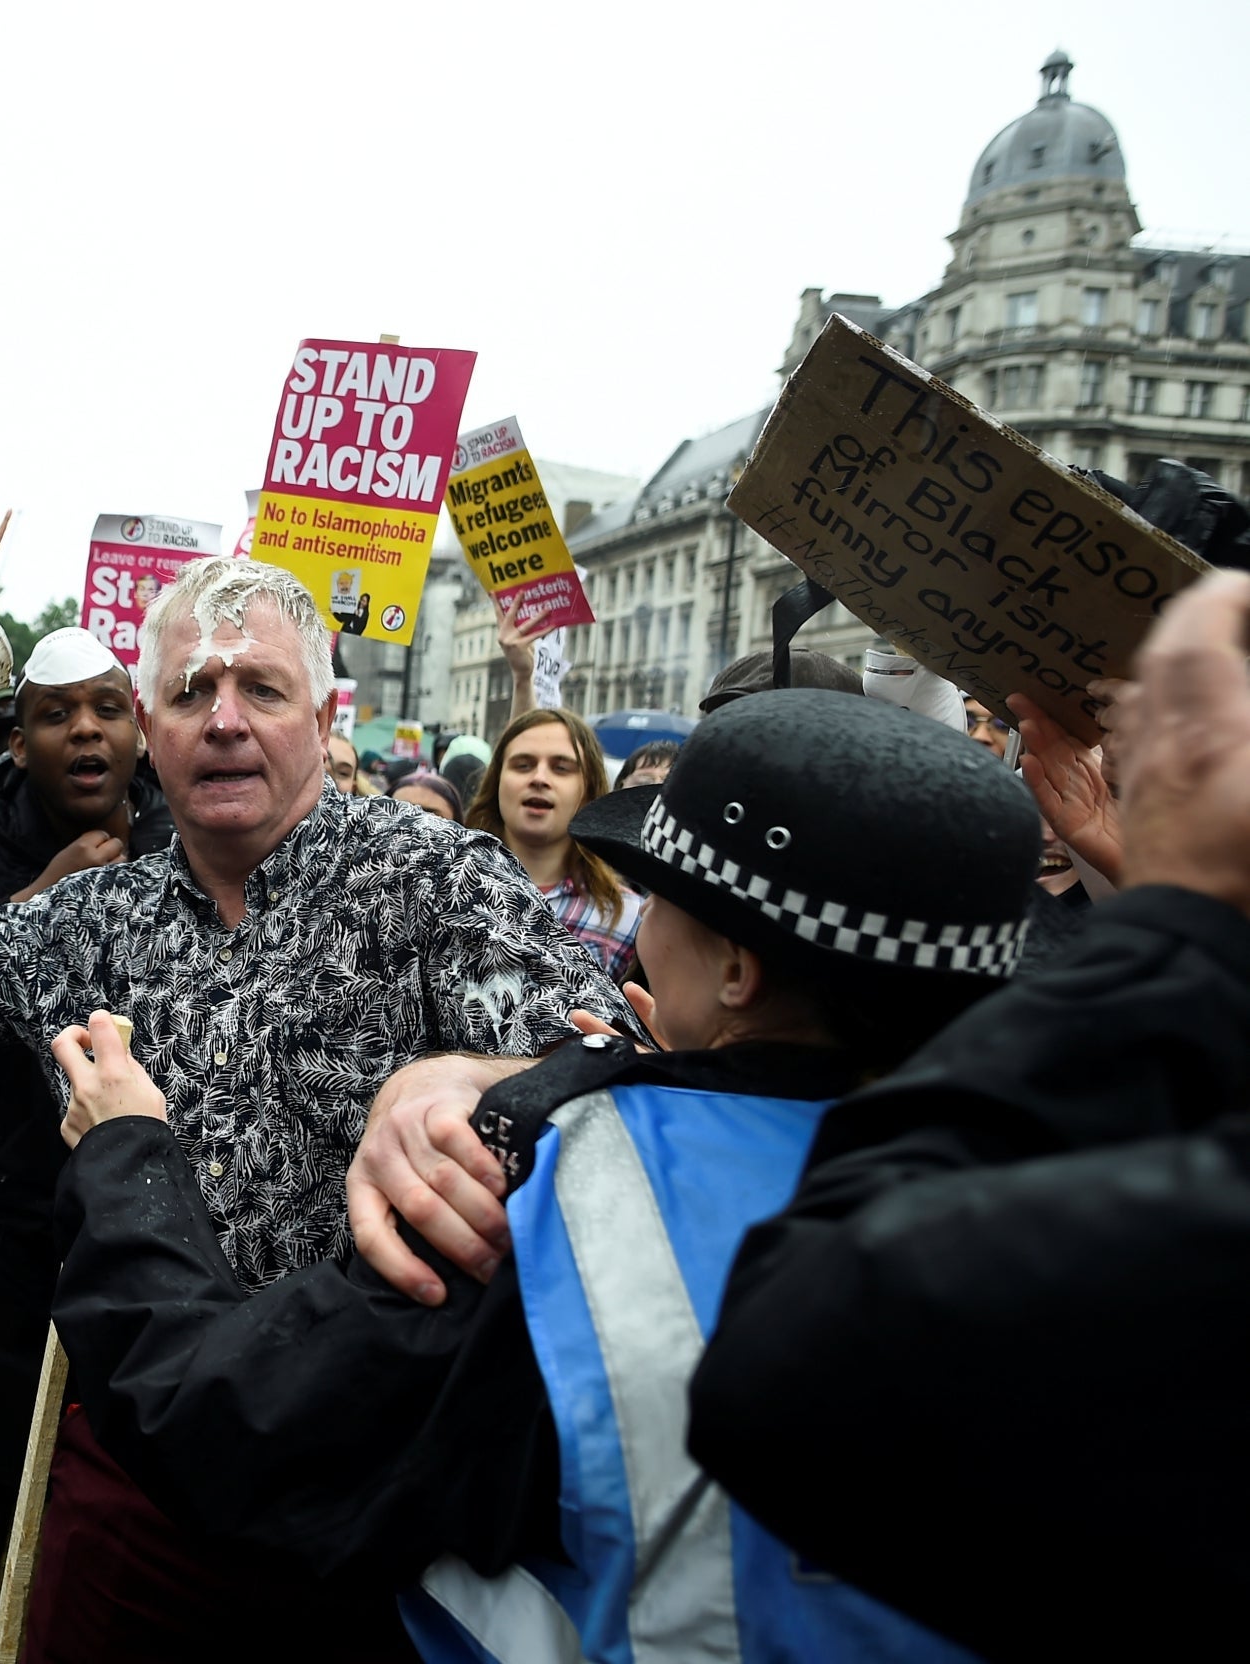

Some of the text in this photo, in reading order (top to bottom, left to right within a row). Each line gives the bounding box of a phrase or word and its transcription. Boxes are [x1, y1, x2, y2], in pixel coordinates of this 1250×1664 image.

[289, 348, 436, 404] STAND
[281, 393, 414, 451] UP TO
[467, 426, 507, 451] STAND UP
[471, 436, 517, 463] TO RACISM
[270, 439, 442, 502] RACISM
[449, 461, 533, 507] Migrants
[859, 354, 1175, 614] This episo
[148, 520, 180, 533] STAND
[263, 502, 426, 543] No to Islamophobia
[453, 491, 548, 536] & refugees
[808, 444, 968, 572] Mirror
[833, 434, 1070, 606] of Black
[162, 534, 198, 548] RACISM
[258, 530, 289, 548] and
[292, 534, 402, 566] antisemitism
[468, 519, 552, 560] welcome
[791, 477, 908, 588] funny
[92, 547, 183, 571] Leave or rem
[489, 553, 544, 584] here
[523, 577, 573, 600] usterity,
